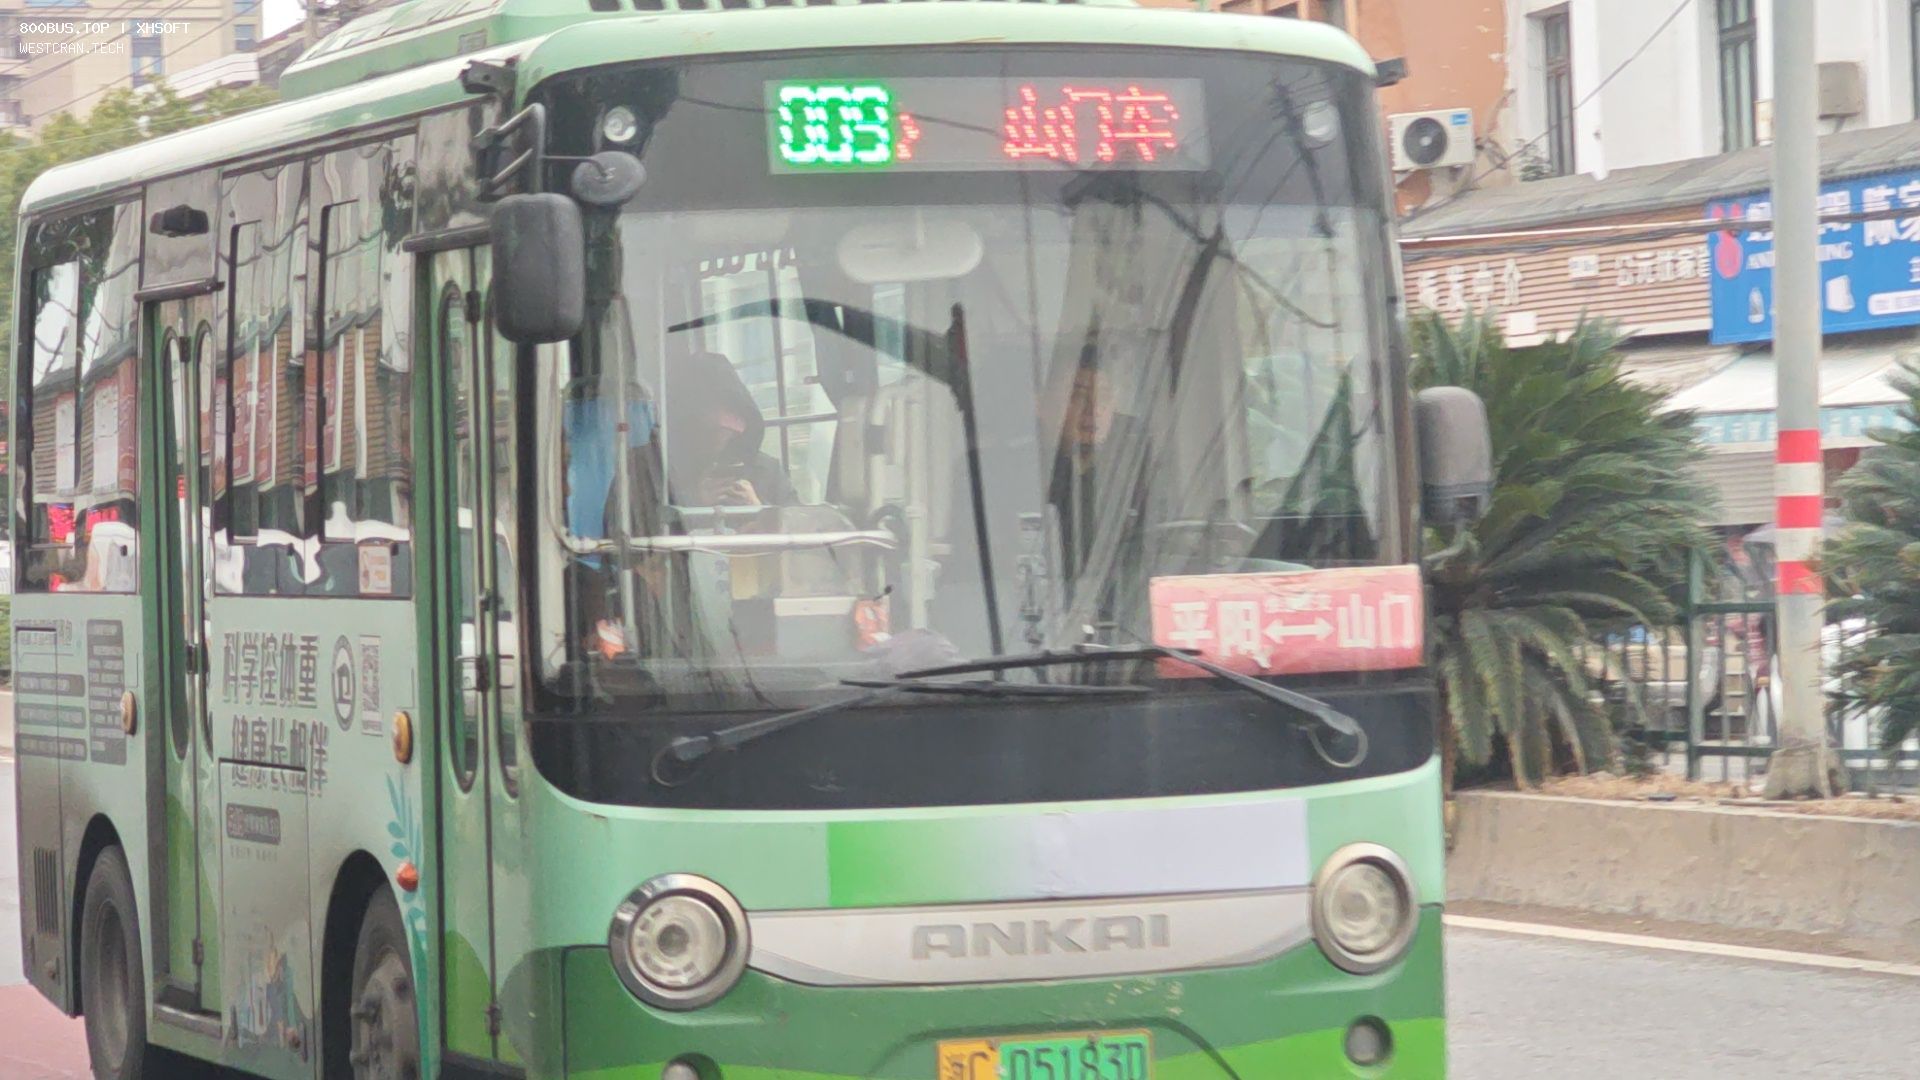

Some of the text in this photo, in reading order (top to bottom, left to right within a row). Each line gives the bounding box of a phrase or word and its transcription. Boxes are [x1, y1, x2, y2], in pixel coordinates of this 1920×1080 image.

[1168, 600, 1263, 658] 平阳
[223, 631, 319, 708] 科学控体重
[231, 713, 329, 798] 健康长相伴
[911, 914, 1170, 960] ANKAI
